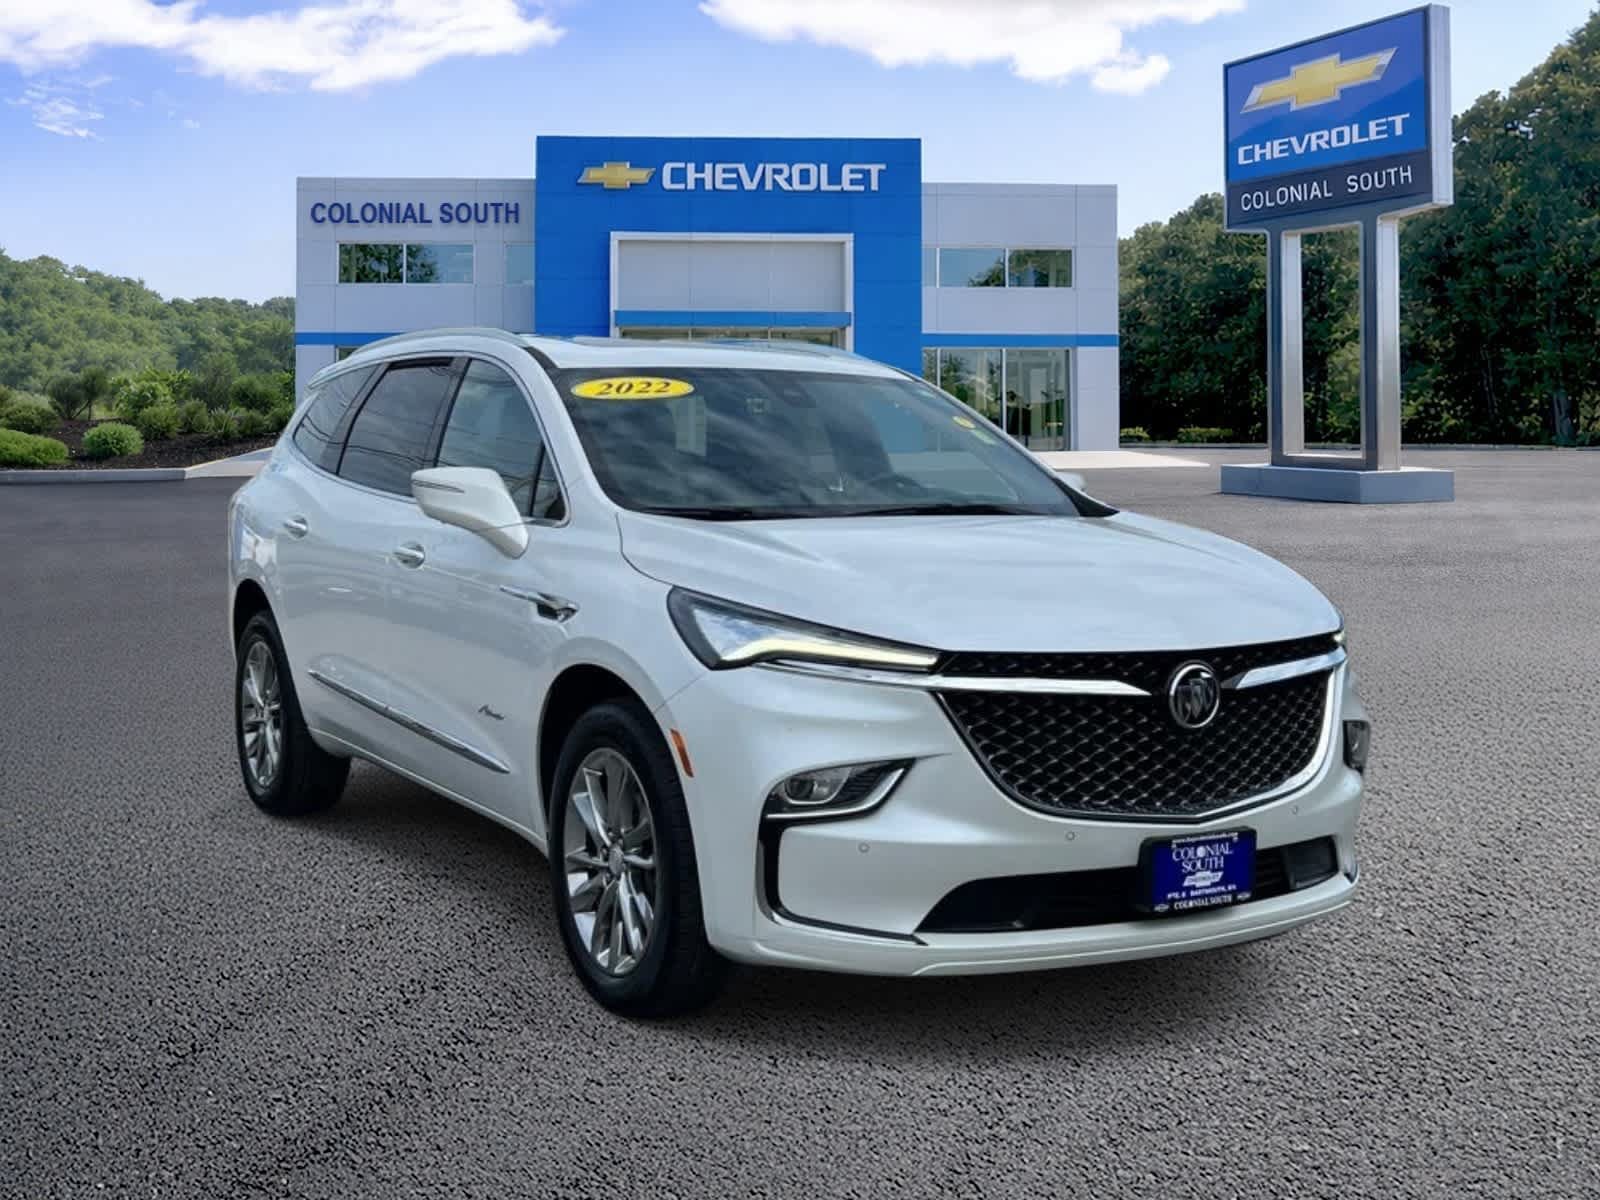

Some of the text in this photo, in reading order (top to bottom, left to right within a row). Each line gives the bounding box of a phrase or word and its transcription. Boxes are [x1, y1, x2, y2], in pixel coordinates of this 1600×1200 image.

[1237, 113, 1410, 166] CHEVROLET
[662, 162, 887, 192] CHEVROLET
[1240, 165, 1413, 211] COLONIAL SOUTH
[310, 202, 520, 225] COLONIAL SOUTH
[594, 381, 671, 396] 2022
[1172, 842, 1233, 862] COLONIAL
[1182, 856, 1224, 873] SOUTH
